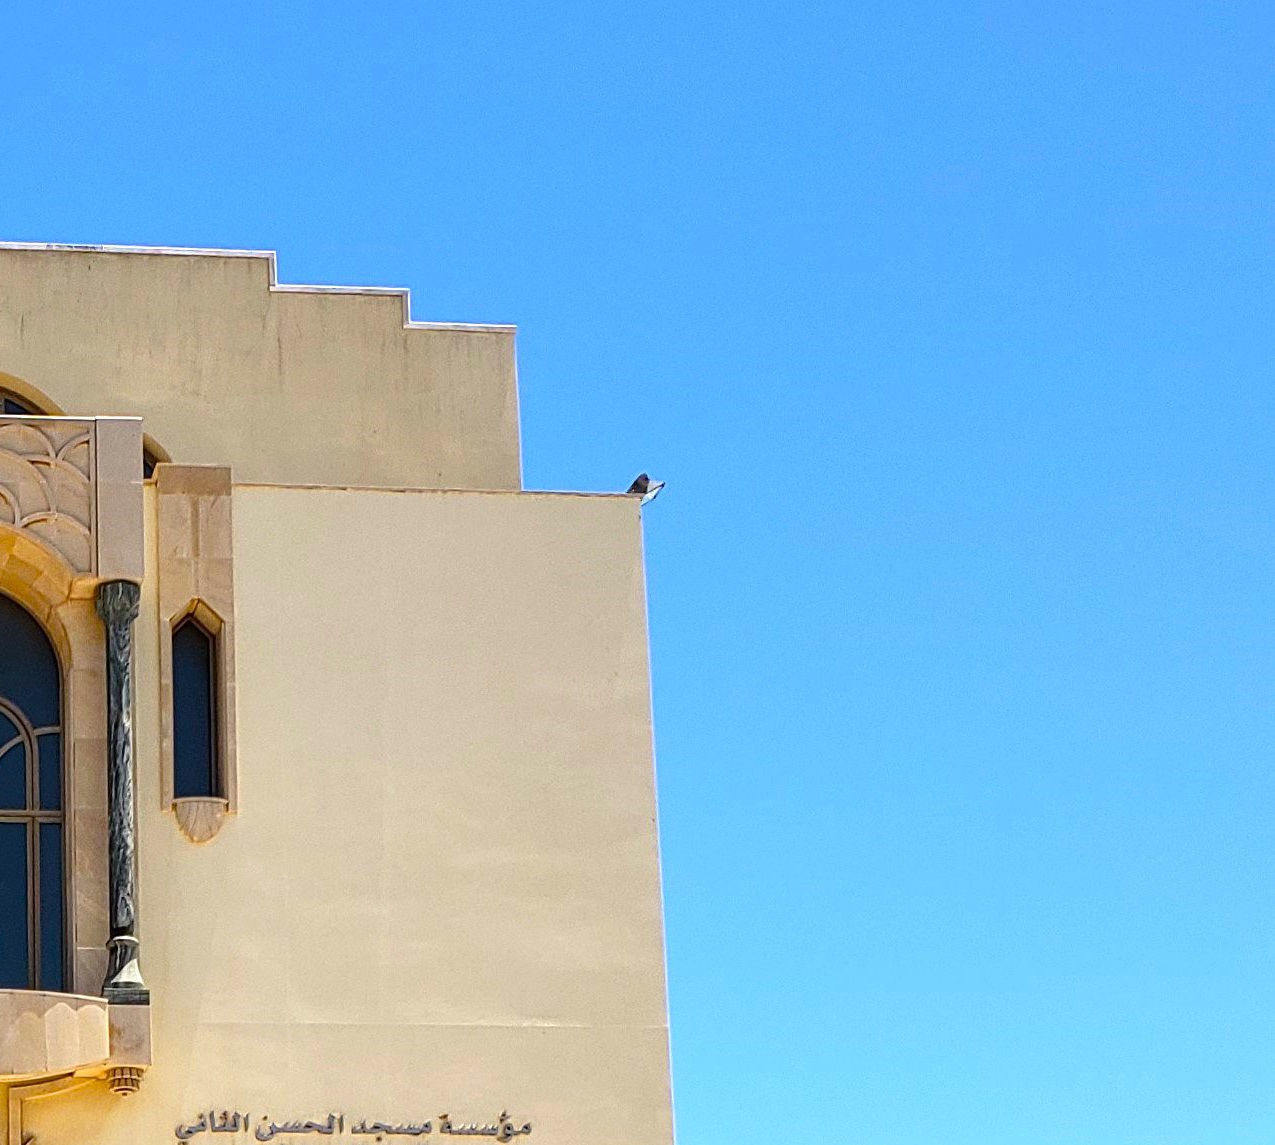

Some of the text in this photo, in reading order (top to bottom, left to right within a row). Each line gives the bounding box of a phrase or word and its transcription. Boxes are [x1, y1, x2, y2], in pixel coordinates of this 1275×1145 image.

[255, 1113, 344, 1142] الحسن
[351, 1120, 432, 1142] مسجد
[439, 1111, 532, 1143] مؤسسة
